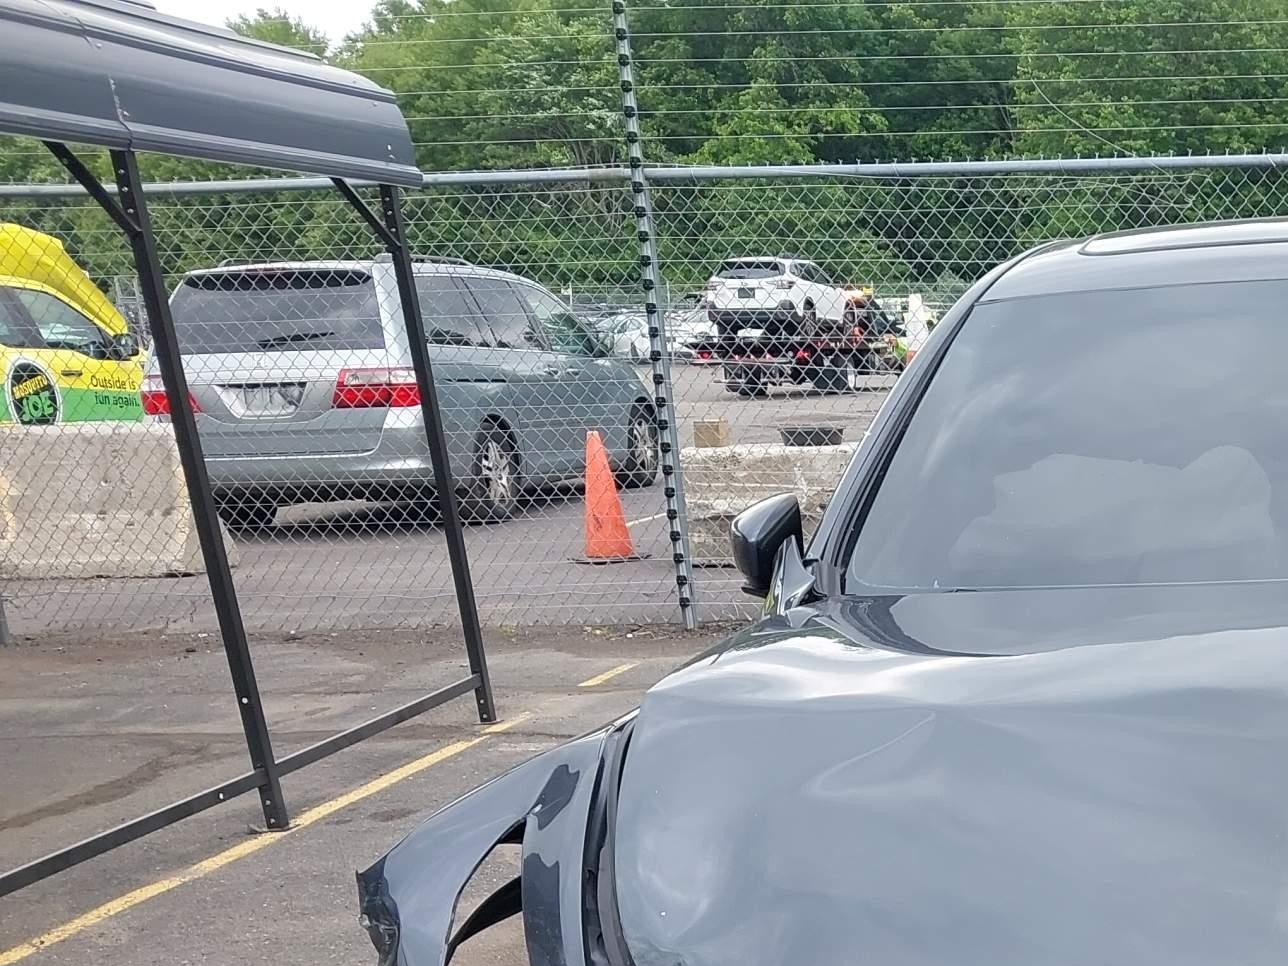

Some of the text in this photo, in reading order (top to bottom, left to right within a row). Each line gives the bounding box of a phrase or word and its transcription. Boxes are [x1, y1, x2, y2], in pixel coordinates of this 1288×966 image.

[90, 376, 137, 390] Outside is
[21, 390, 54, 422] JOE
[95, 392, 140, 409] fun again.
